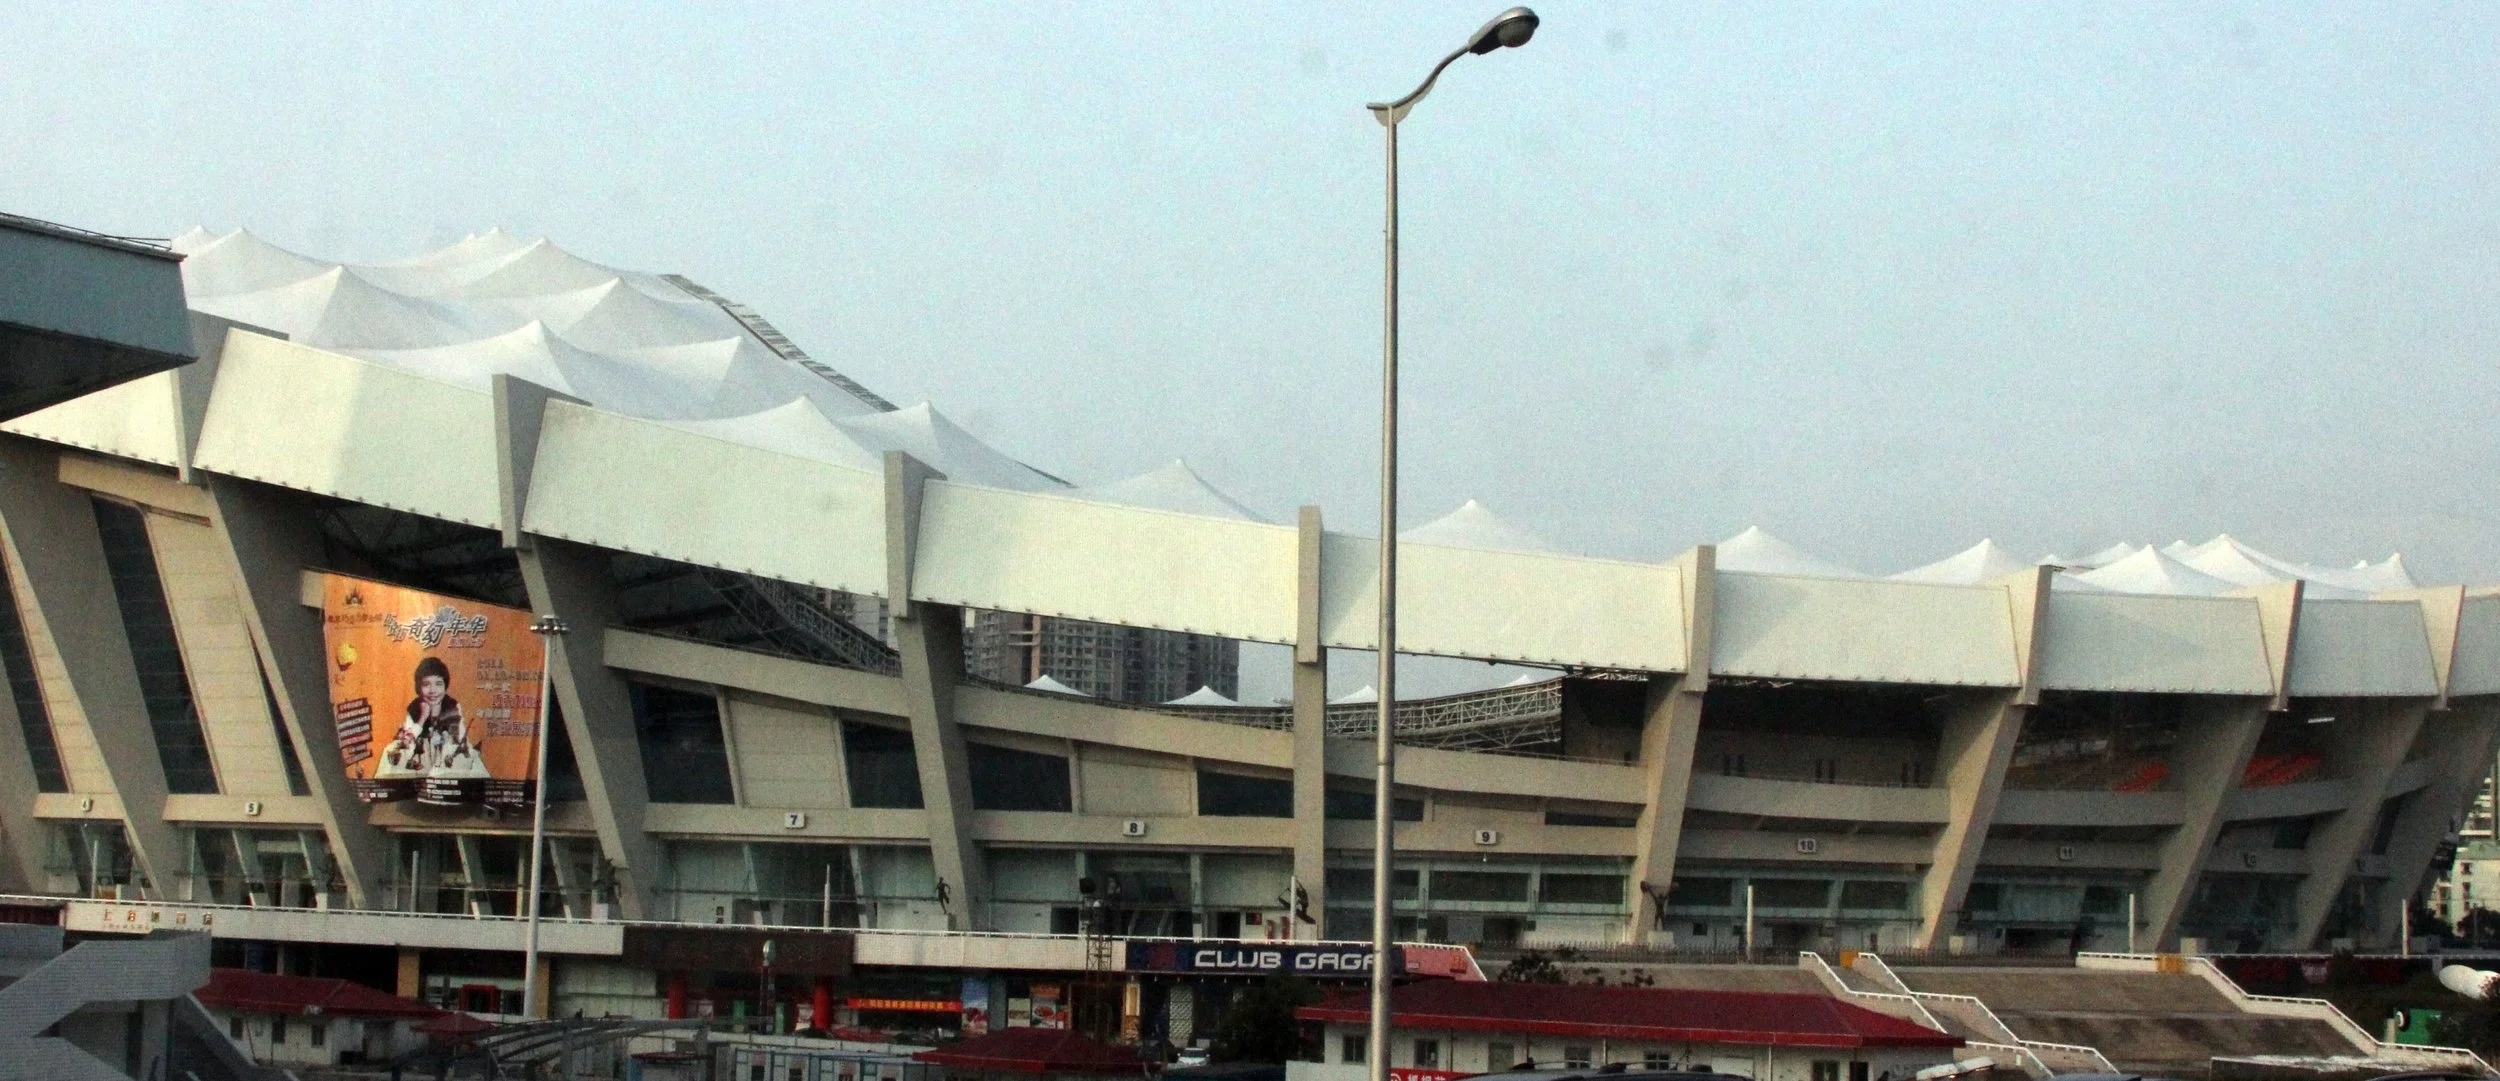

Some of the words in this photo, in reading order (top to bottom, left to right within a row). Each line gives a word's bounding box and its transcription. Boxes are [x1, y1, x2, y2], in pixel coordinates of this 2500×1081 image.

[790, 814, 798, 825] 7
[1130, 822, 1138, 833] 8
[1481, 831, 1490, 842] 9
[1800, 840, 1814, 851] 10
[1195, 950, 1282, 969] CLUB
